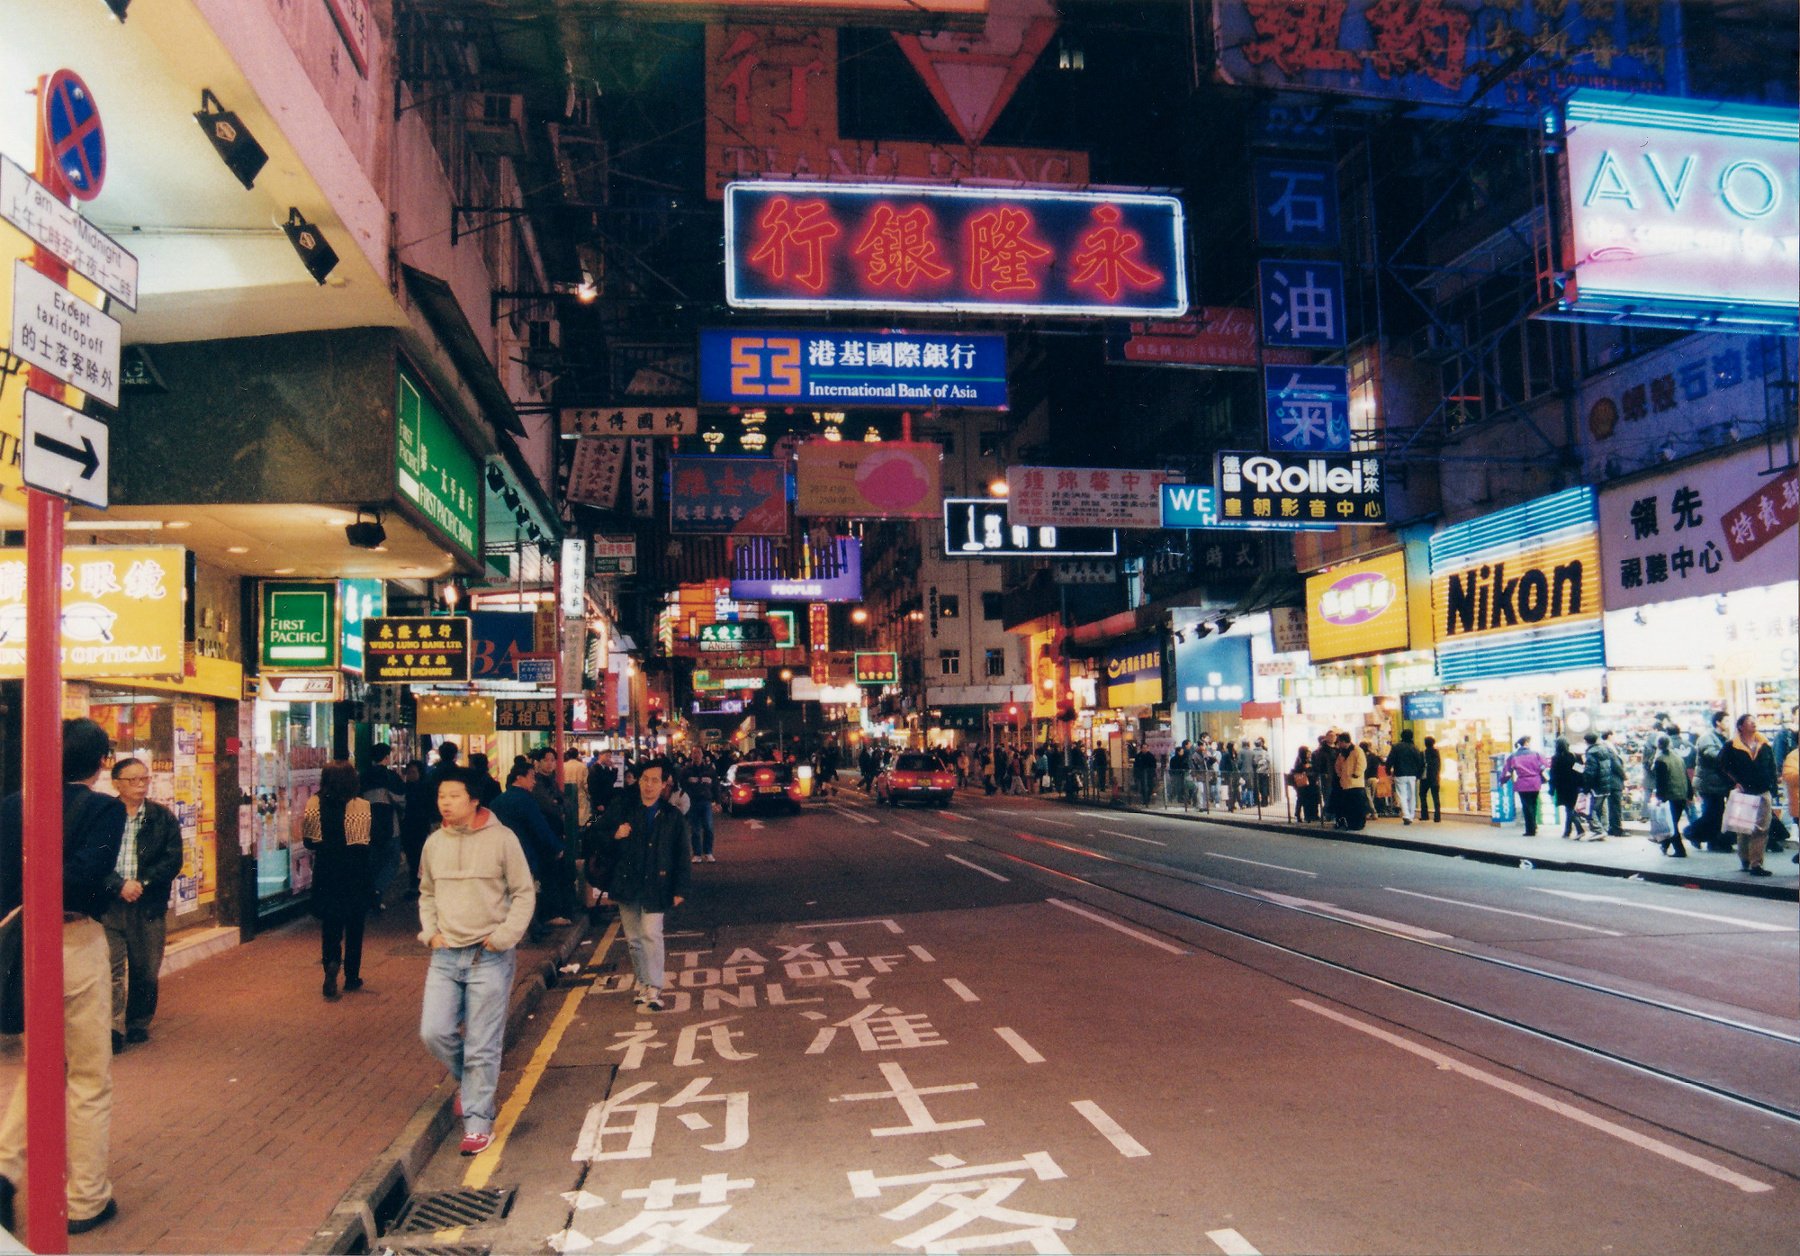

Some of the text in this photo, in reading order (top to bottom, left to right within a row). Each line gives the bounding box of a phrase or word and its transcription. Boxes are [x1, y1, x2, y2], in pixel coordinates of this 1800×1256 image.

[24, 177, 122, 269] 7 am Midnight
[54, 291, 91, 328] Except
[22, 323, 114, 391] 的士落客除外
[809, 340, 976, 370] 港基國際銀行
[809, 381, 977, 399] International Bank of Asia
[420, 442, 473, 520] 第一太平銀行
[1241, 456, 1362, 494] Rollei
[419, 481, 473, 551] FIRST PACIFIC BANK
[1225, 497, 1381, 518] 皇朝影音中心
[1630, 486, 1703, 540] 領先
[1620, 540, 1723, 590] 視聽中心
[1447, 559, 1583, 637] Nikon
[270, 618, 306, 630] FIRST
[270, 631, 321, 643] PACIFIC
[71, 645, 167, 663] OPTICAL
[369, 641, 394, 649] WING
[396, 641, 420, 649] LUNG
[422, 641, 445, 649] BANK
[380, 667, 453, 677] MONEY EXCHANGE
[669, 940, 848, 969] TAXI
[785, 953, 907, 980] OFF
[636, 976, 876, 1015] ONLY
[571, 1061, 987, 1162] 的士
